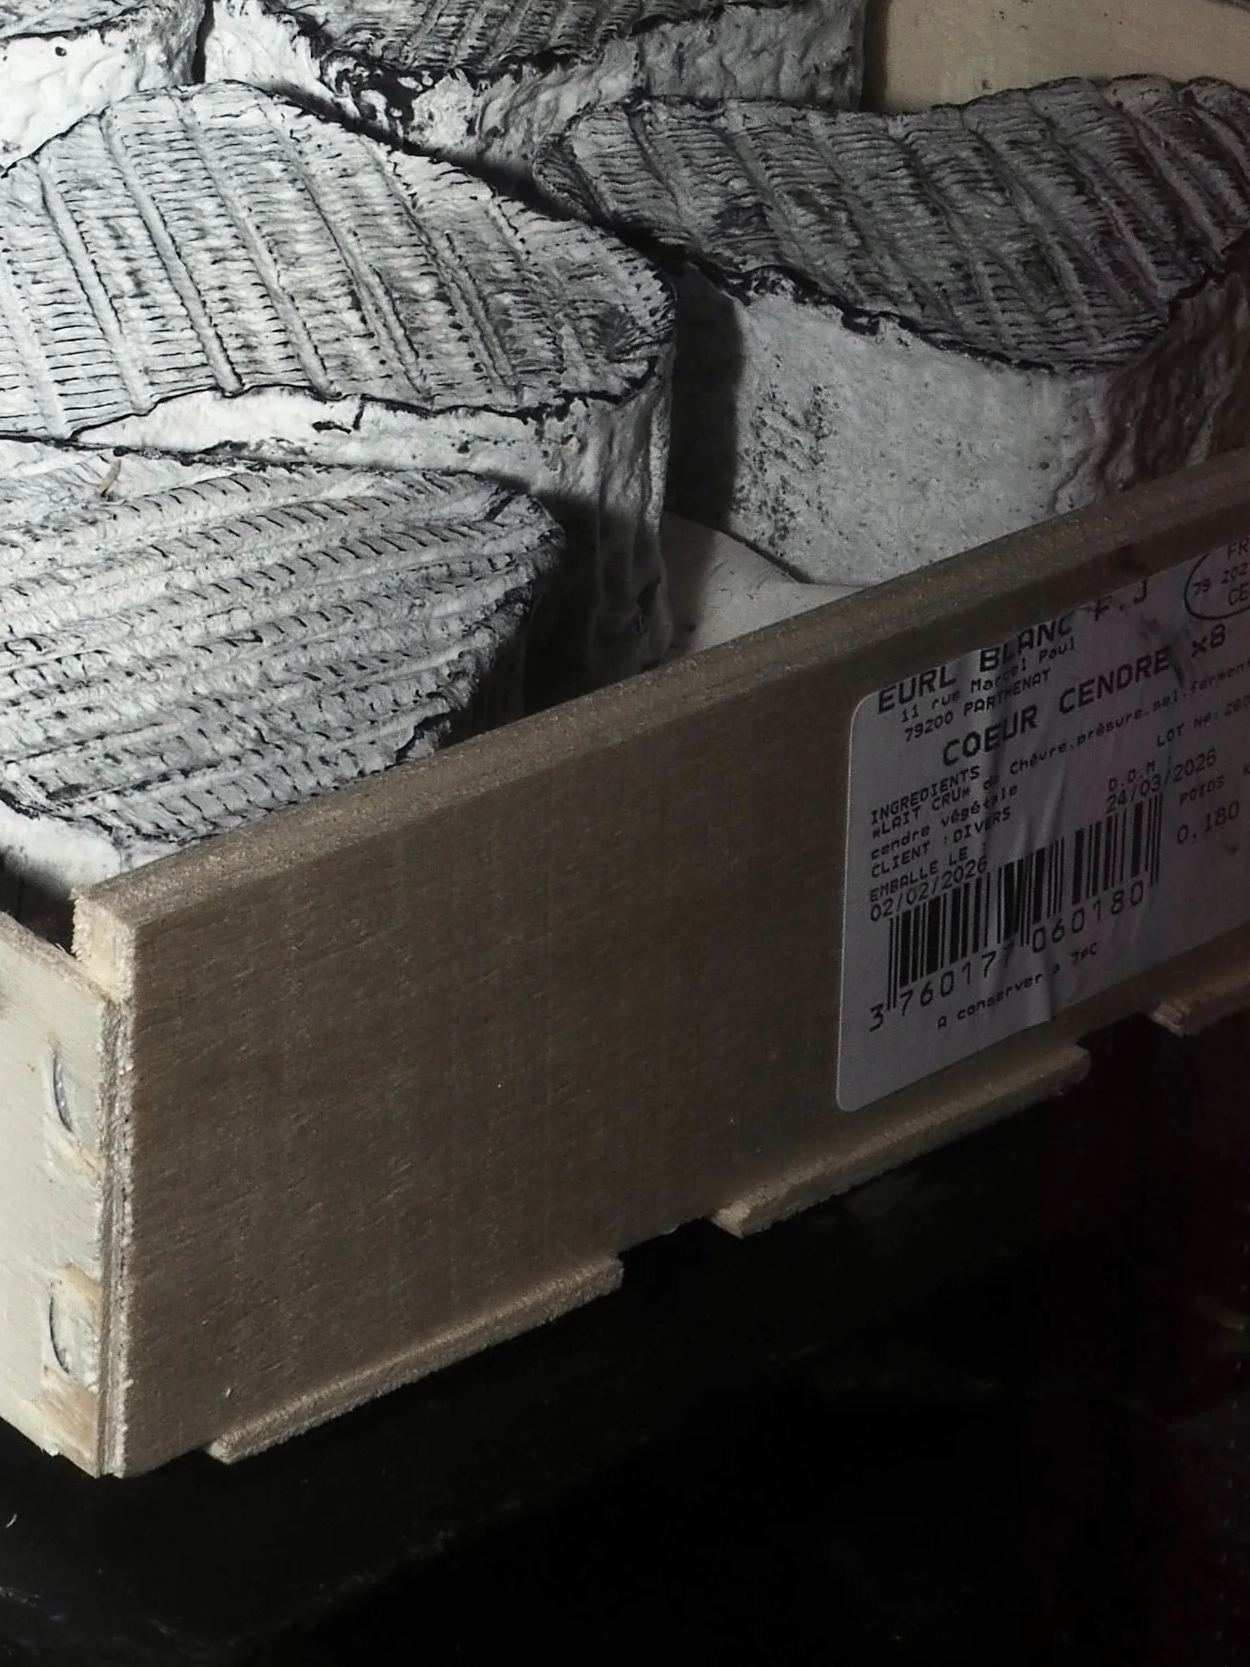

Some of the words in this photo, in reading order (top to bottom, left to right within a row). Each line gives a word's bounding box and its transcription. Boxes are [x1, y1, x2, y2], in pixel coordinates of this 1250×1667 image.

[878, 666, 956, 715] EURL
[980, 615, 1072, 672] BLANC
[901, 704, 919, 723] 11
[931, 691, 960, 710] rue
[970, 657, 1027, 693] Marcel
[1038, 636, 1075, 663] Paul
[904, 711, 954, 742] 79200
[963, 667, 1052, 716] PARTHENAY
[943, 704, 1038, 766] COEUR
[1060, 645, 1172, 715] CENDRE
[1156, 723, 1185, 748] LOT
[870, 766, 981, 826] INGREDIENTS
[1106, 748, 1217, 814] 24/03/2026
[870, 860, 940, 903] EMBALLE
[948, 846, 969, 867] LE
[871, 825, 930, 860] cendre
[871, 841, 931, 879] CLIENT
[870, 854, 988, 922] 02/02/2026
[869, 1004, 884, 1032] 3
[1032, 881, 1145, 954] 060180
[957, 972, 1044, 1021] conserver
